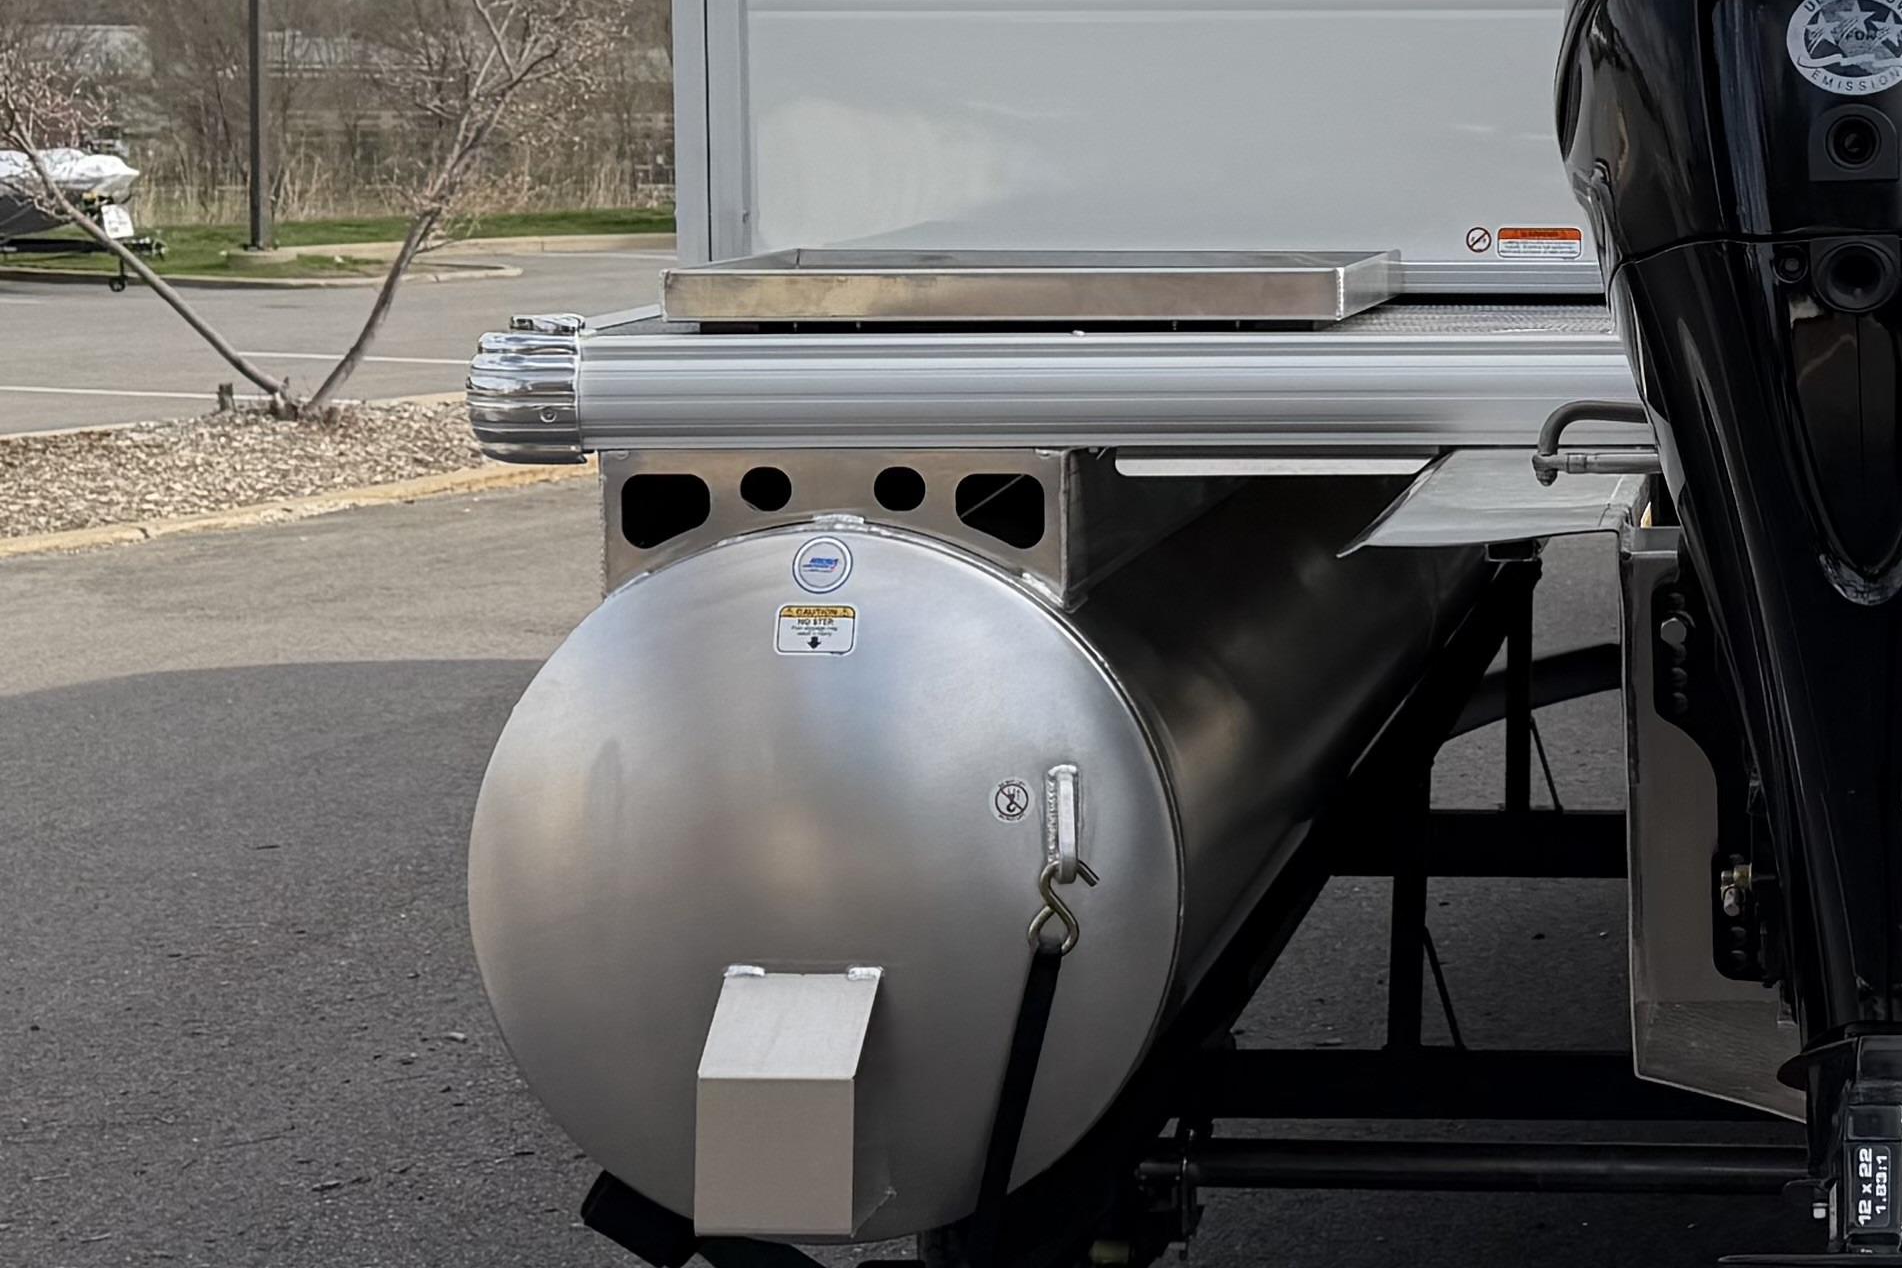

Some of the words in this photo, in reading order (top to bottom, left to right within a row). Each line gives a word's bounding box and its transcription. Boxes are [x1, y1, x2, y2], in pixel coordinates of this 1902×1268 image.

[795, 608, 838, 616] CAUTION
[1859, 1148, 1872, 1177] 22
[1858, 1200, 1872, 1227] 12
